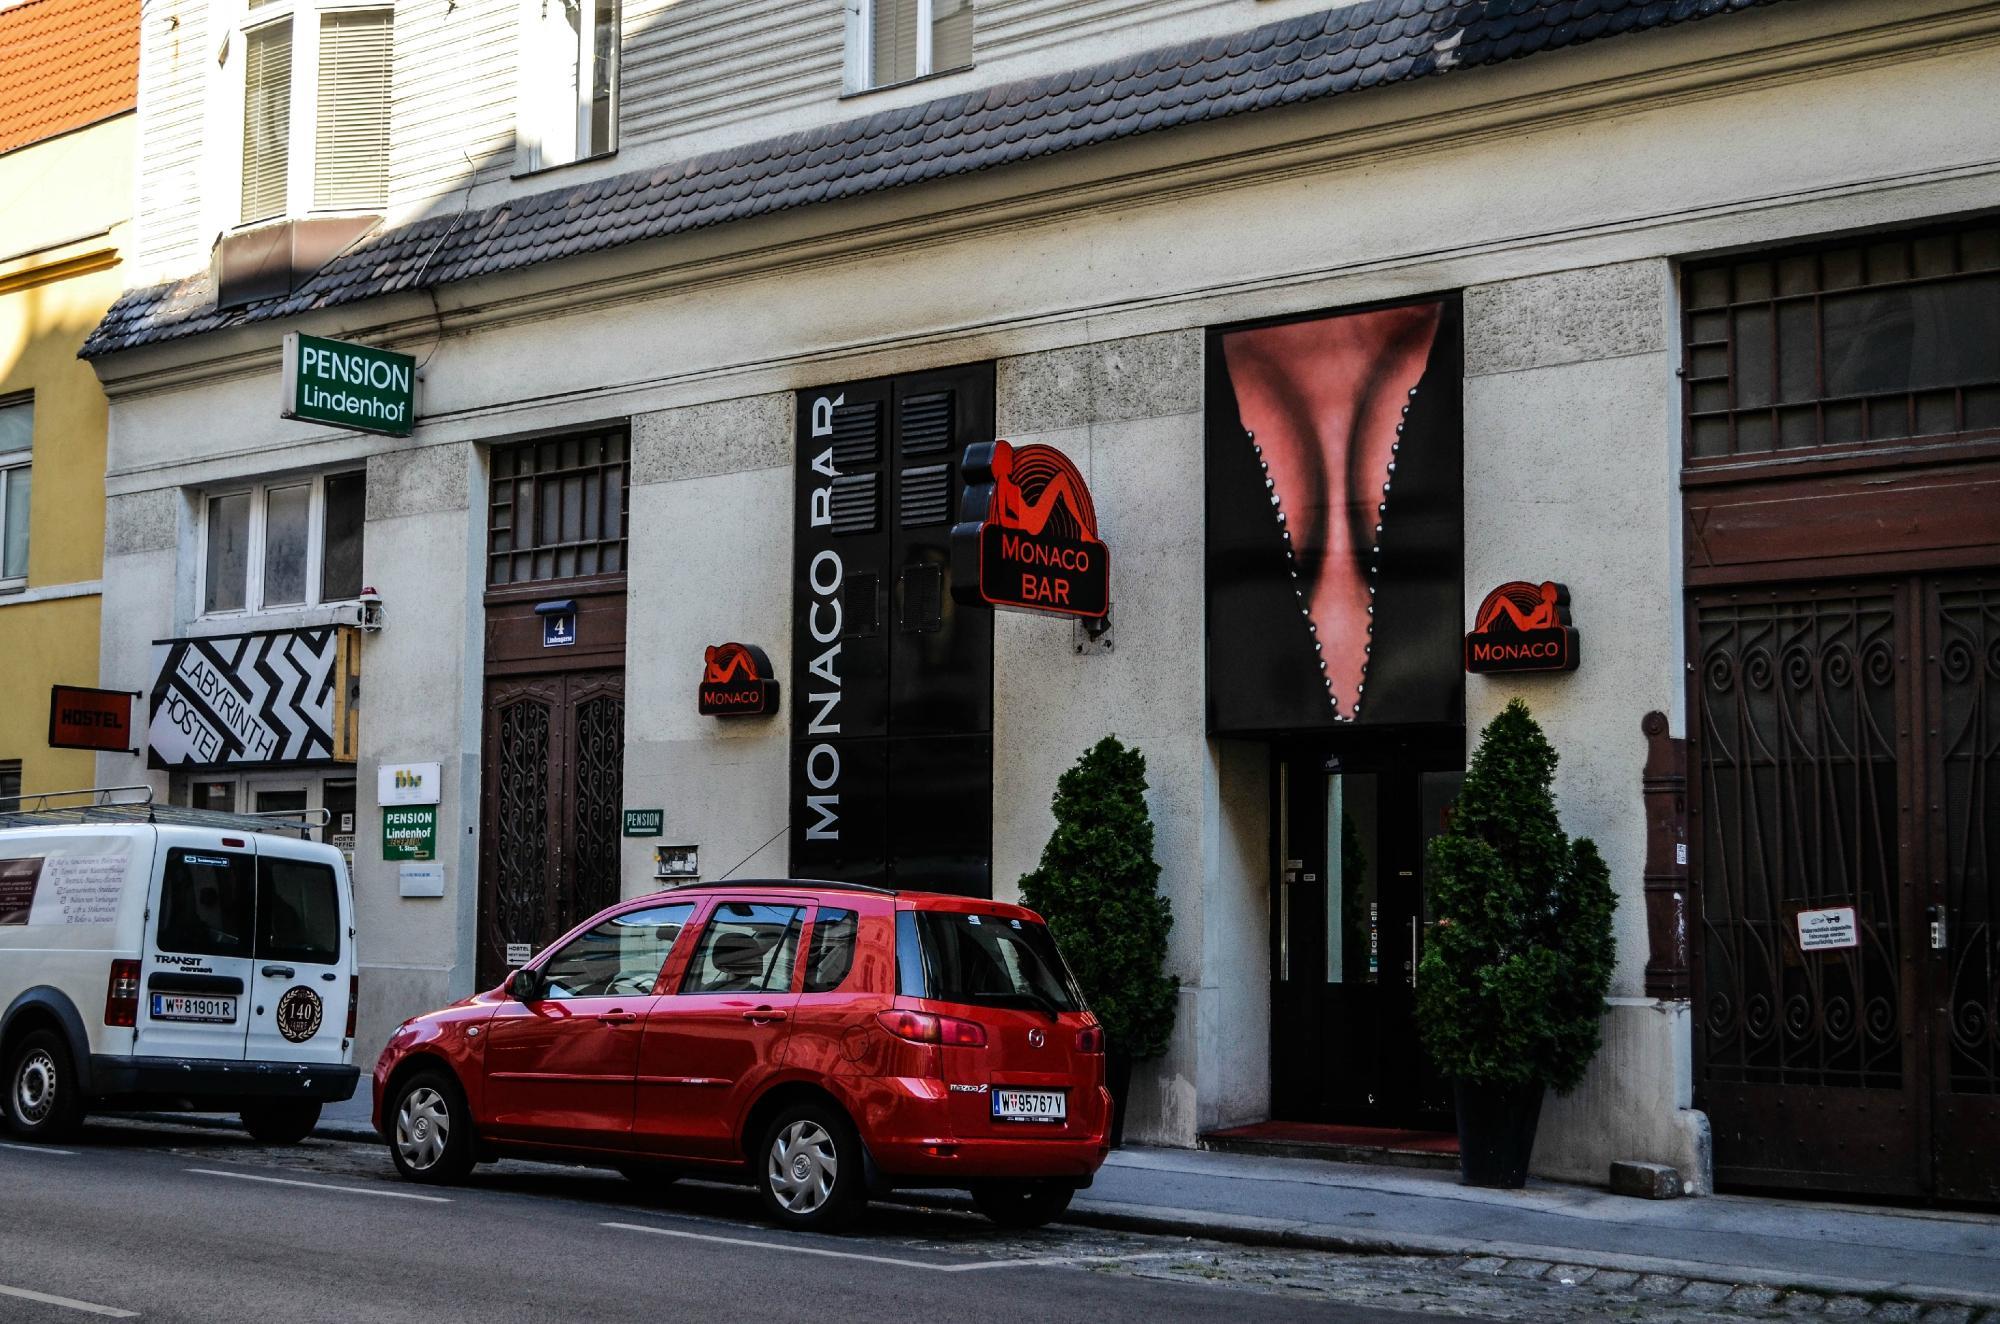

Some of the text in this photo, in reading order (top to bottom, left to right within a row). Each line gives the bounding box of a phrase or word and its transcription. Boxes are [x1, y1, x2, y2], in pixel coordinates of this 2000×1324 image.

[302, 346, 409, 394] PENSION
[303, 383, 405, 422] Lindenhof
[1001, 534, 1089, 572] MONACO
[1022, 573, 1070, 605] BAR
[806, 391, 844, 841] MONACO BAR
[554, 617, 565, 635] 4
[1474, 642, 1559, 661] MONACO
[180, 647, 273, 761] LABYRINTH
[704, 691, 759, 705] MONACO
[61, 708, 123, 729] HOSTEL
[165, 693, 218, 763] HOSTEL
[387, 813, 432, 824] PENSION
[627, 812, 660, 827] PENSION
[386, 827, 431, 839] Lindenhof
[155, 955, 202, 966] TRANSIT
[166, 998, 174, 1013] W
[290, 1003, 311, 1020] 140
